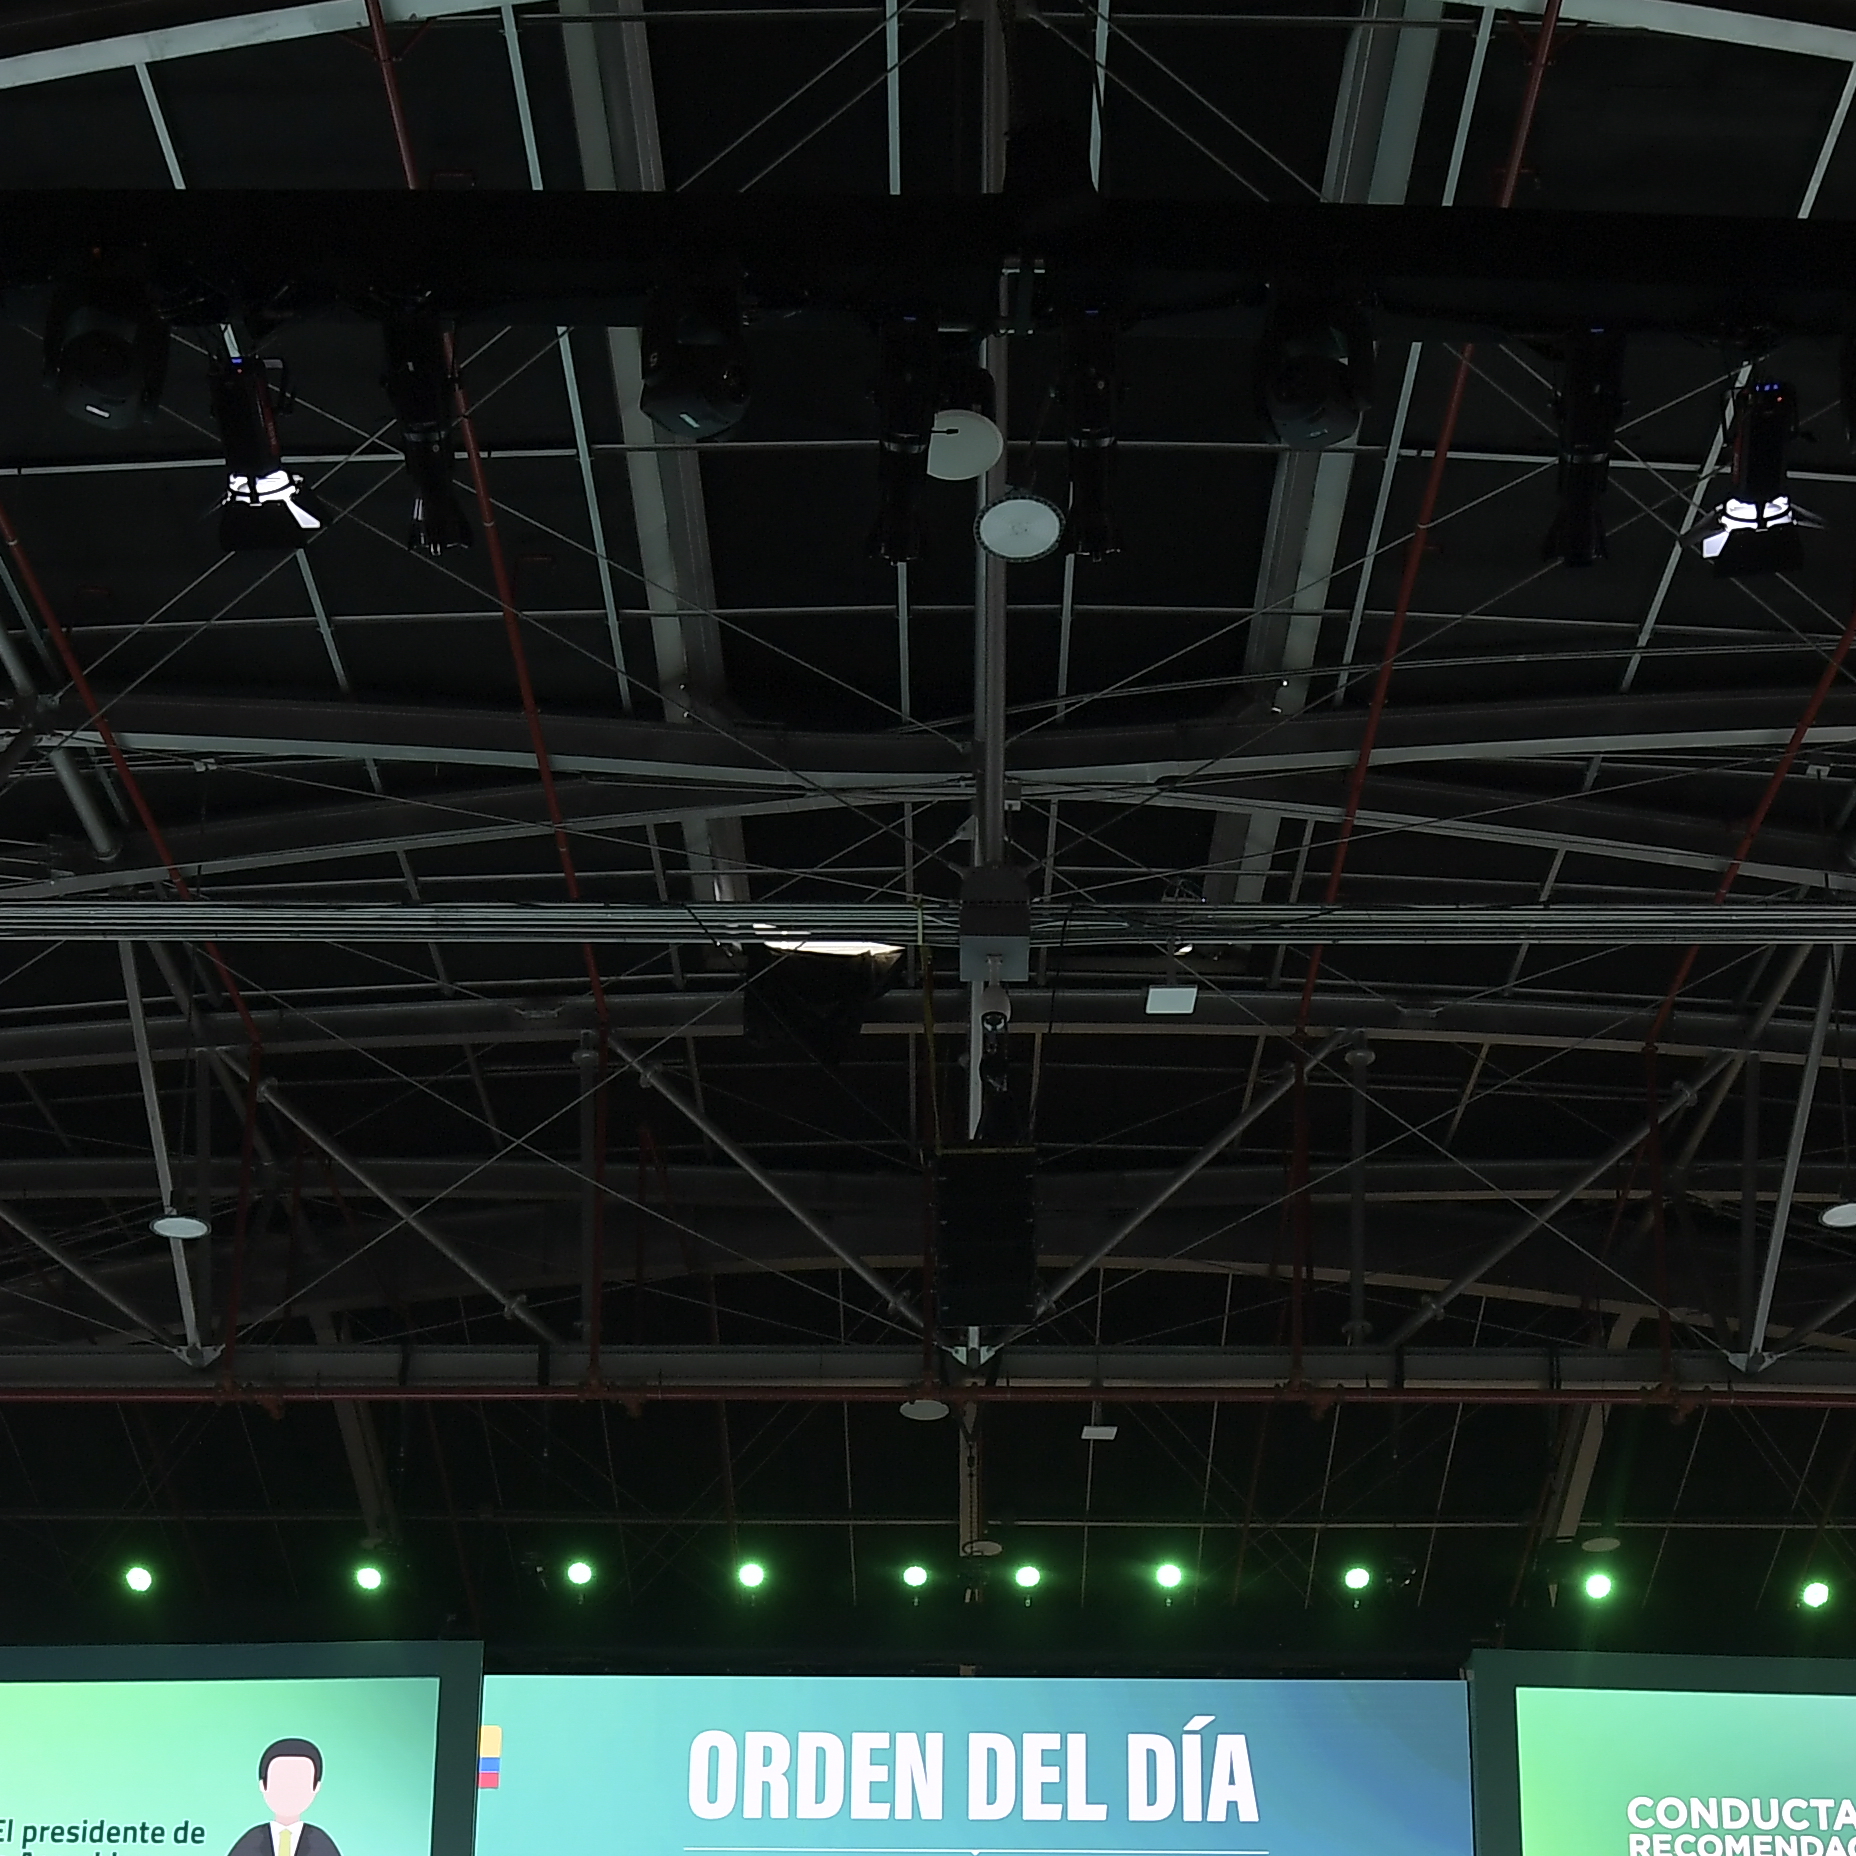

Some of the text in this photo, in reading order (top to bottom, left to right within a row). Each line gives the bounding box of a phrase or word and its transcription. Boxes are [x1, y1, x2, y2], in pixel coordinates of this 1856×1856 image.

[689, 1716, 1259, 1822] ORDEN DEL DÍA
[22, 1820, 165, 1849] presidente
[174, 1820, 205, 1844] de
